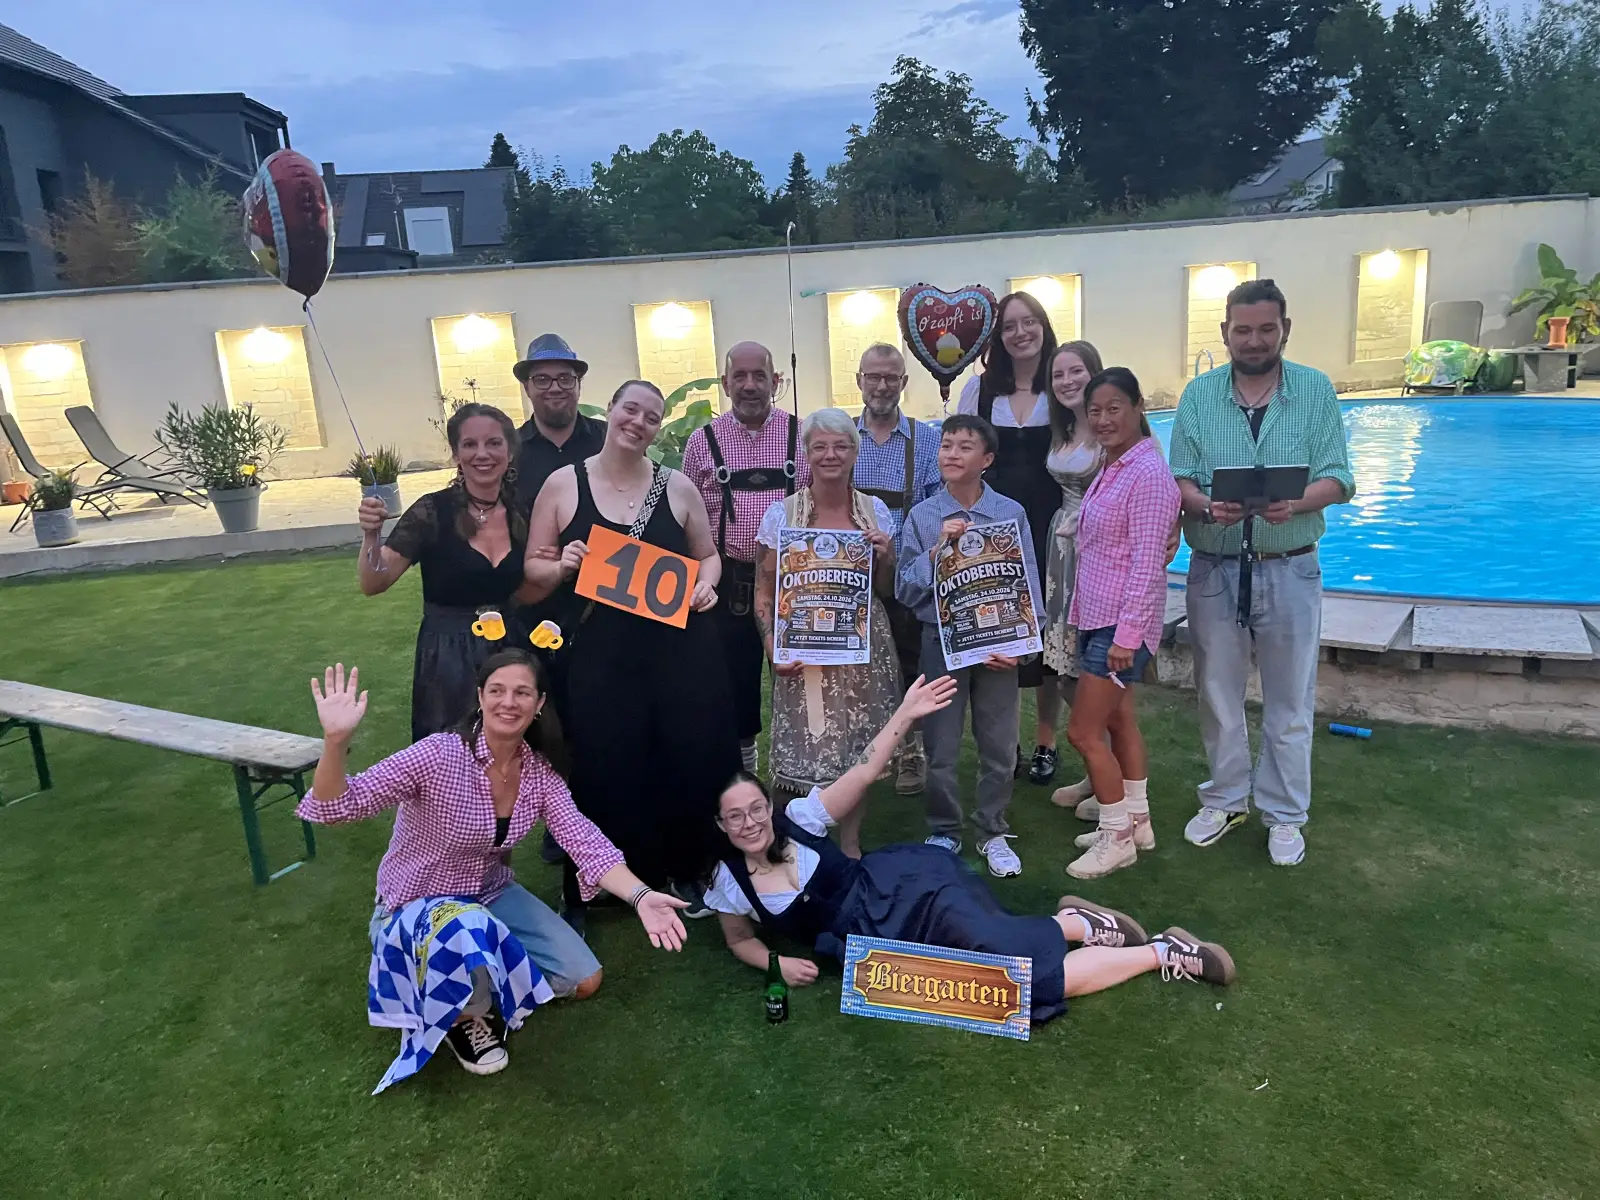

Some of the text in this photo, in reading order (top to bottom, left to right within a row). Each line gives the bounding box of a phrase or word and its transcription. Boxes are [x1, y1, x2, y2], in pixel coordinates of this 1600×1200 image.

[919, 305, 983, 333] O'zapft is!
[596, 543, 688, 618] 10
[783, 569, 868, 590] OKTOBERFEST
[940, 562, 1022, 597] OKTOBERFEST
[823, 595, 852, 603] 24.10.2026
[980, 587, 1011, 597] 24.10.2026
[975, 631, 994, 639] TICKETS
[866, 960, 1009, 1008] Biergarten
